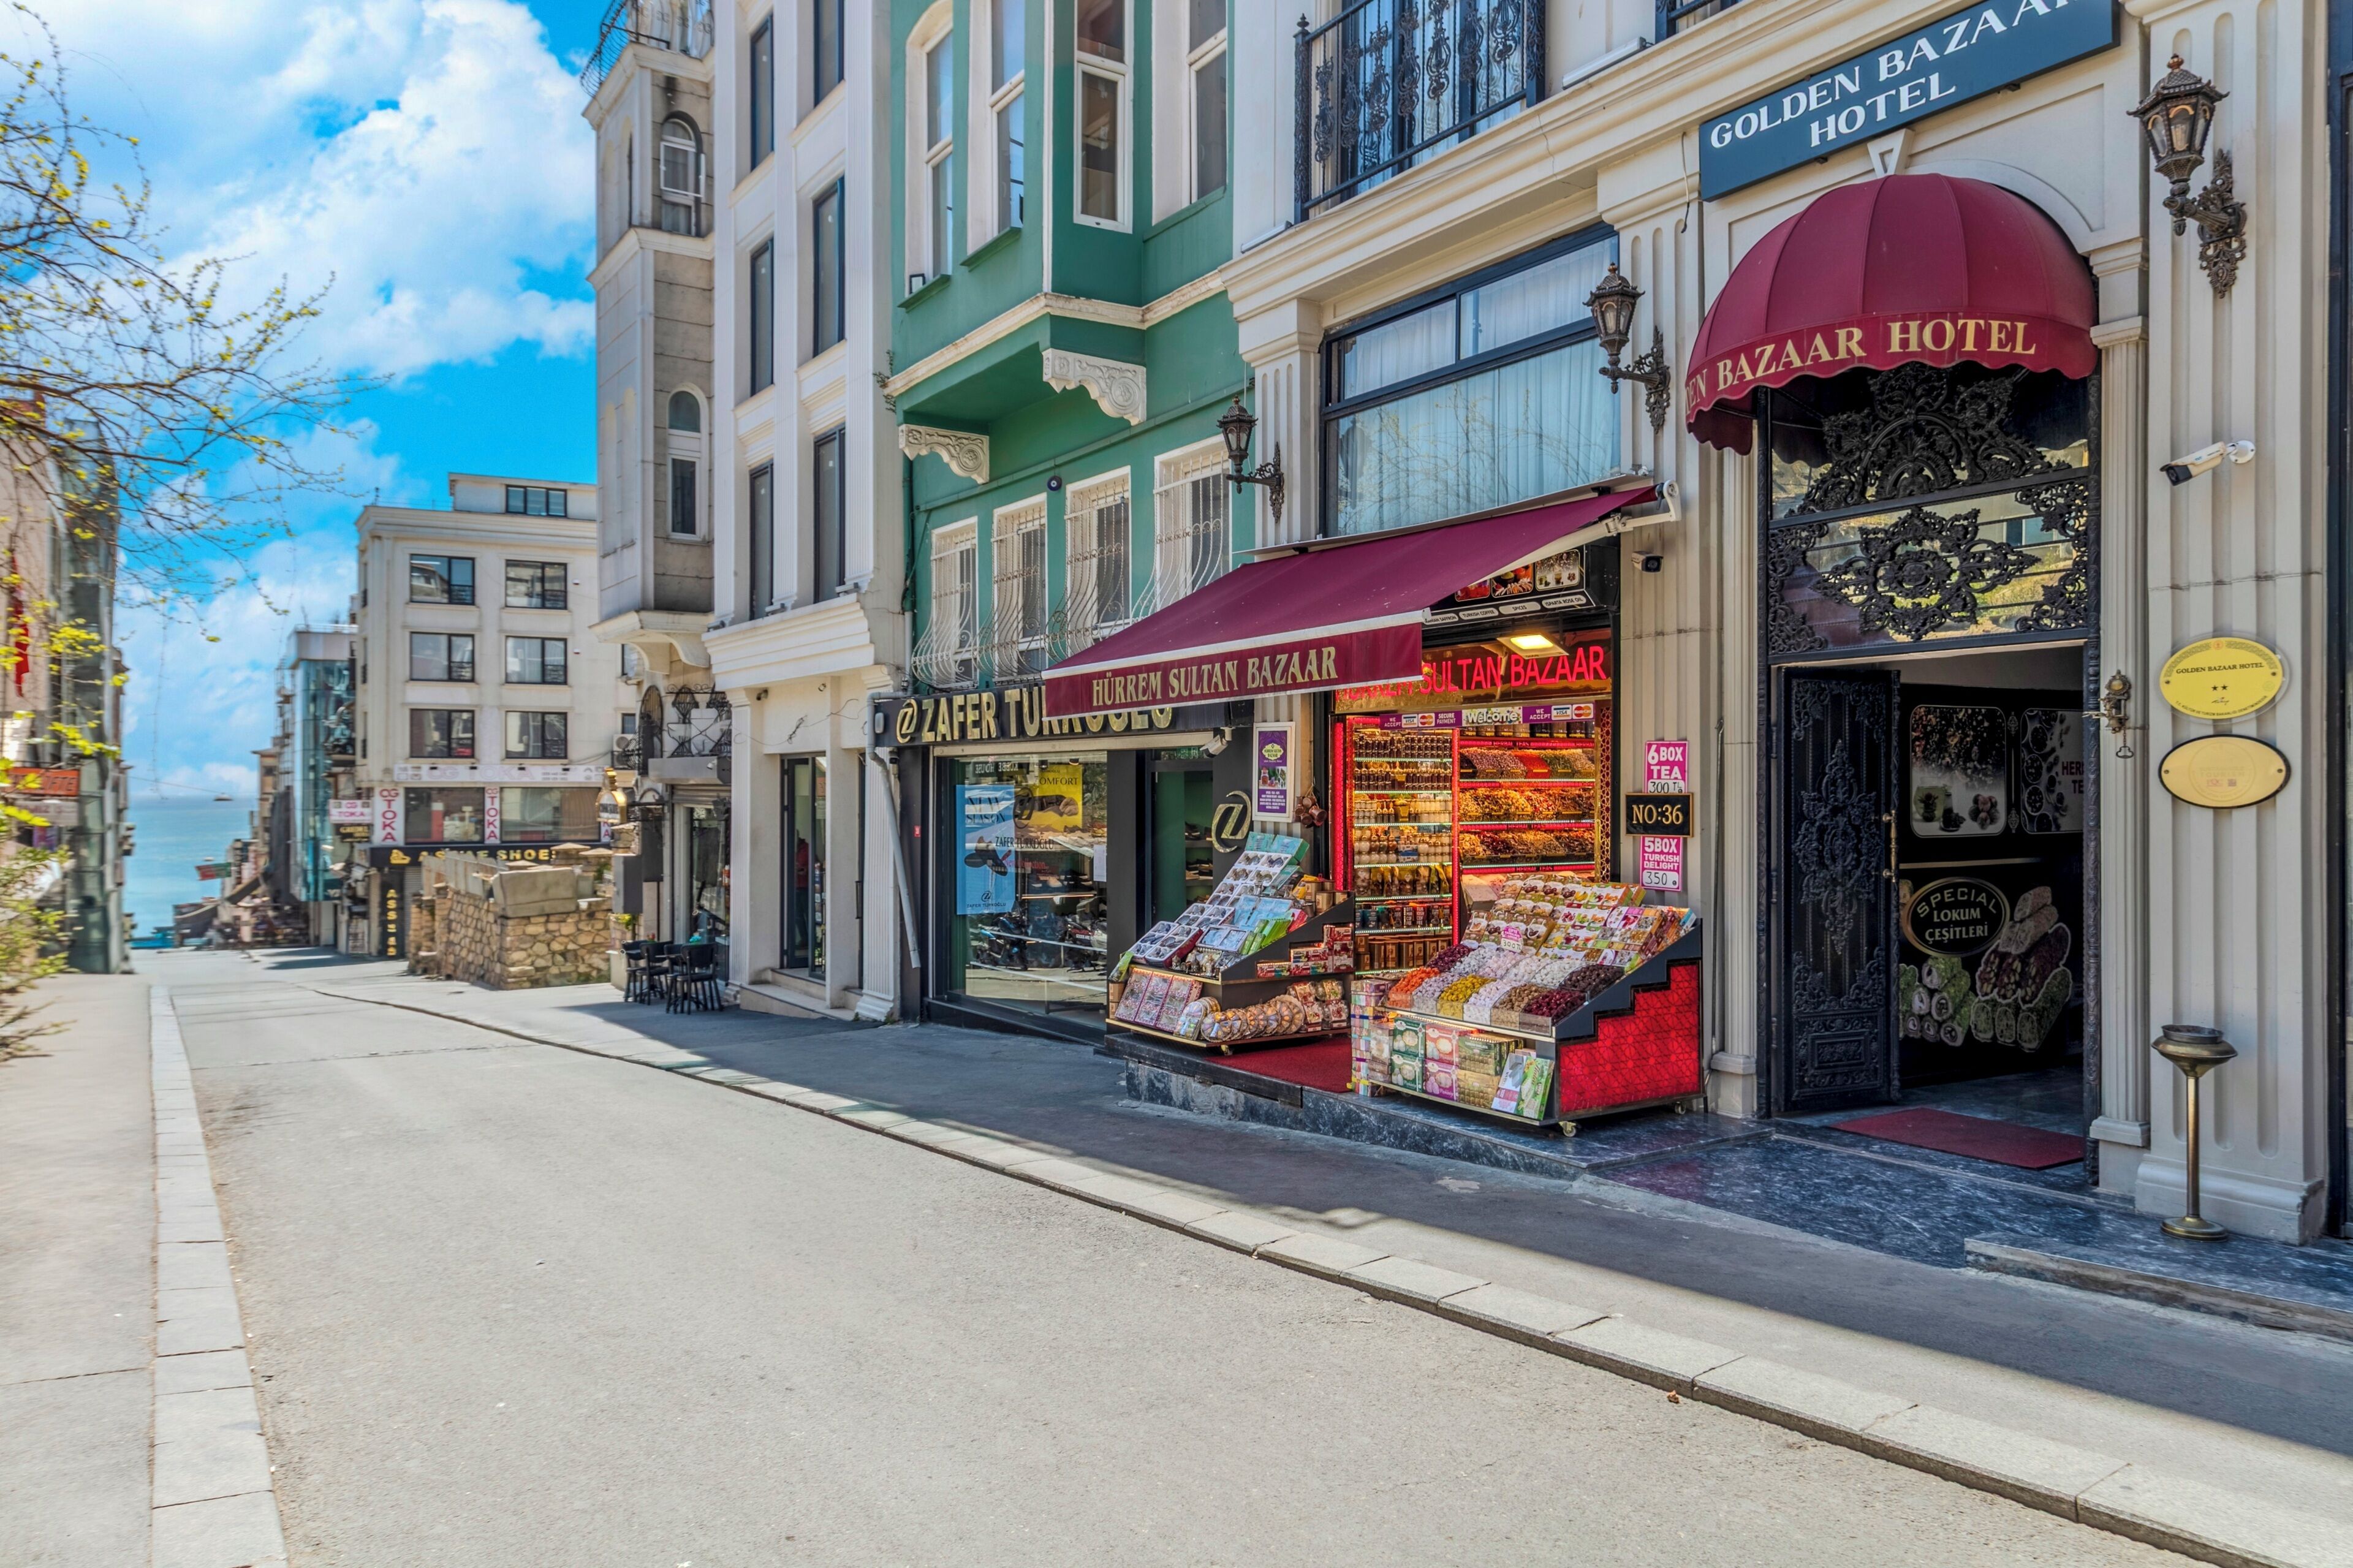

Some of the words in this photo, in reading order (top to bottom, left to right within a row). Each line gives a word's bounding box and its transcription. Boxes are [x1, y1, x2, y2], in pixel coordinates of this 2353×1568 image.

[1710, 66, 1860, 149] GOLDEN
[1878, 0, 2077, 81] BAZAA
[1809, 72, 1957, 148] HOTEL
[1717, 327, 1867, 391] BAZAAR
[1887, 319, 2036, 355] HOTEL
[1092, 672, 1162, 706] HÜRREM
[1169, 661, 1238, 698] SULTAN
[1248, 646, 1338, 689] BAZAAR
[1420, 656, 1501, 695] SULTAN
[1511, 646, 1607, 687] BAZAAR
[922, 692, 996, 742] ZAFER
[1467, 711, 1518, 724] Welcome
[1650, 766, 1682, 779] TEA
[1649, 781, 1669, 793] 300
[1632, 805, 1683, 825] NO:36
[996, 836, 1014, 847] ZAFER
[497, 849, 556, 860] SHOE
[1644, 853, 1680, 863] TURKISH
[1643, 861, 1679, 870] DELIGHT
[1645, 871, 1667, 886] 350
[1917, 888, 1997, 918] SPECIAL
[1933, 907, 1981, 922] LOKUM
[1925, 922, 1988, 944] ÇEŞİTLERİ
